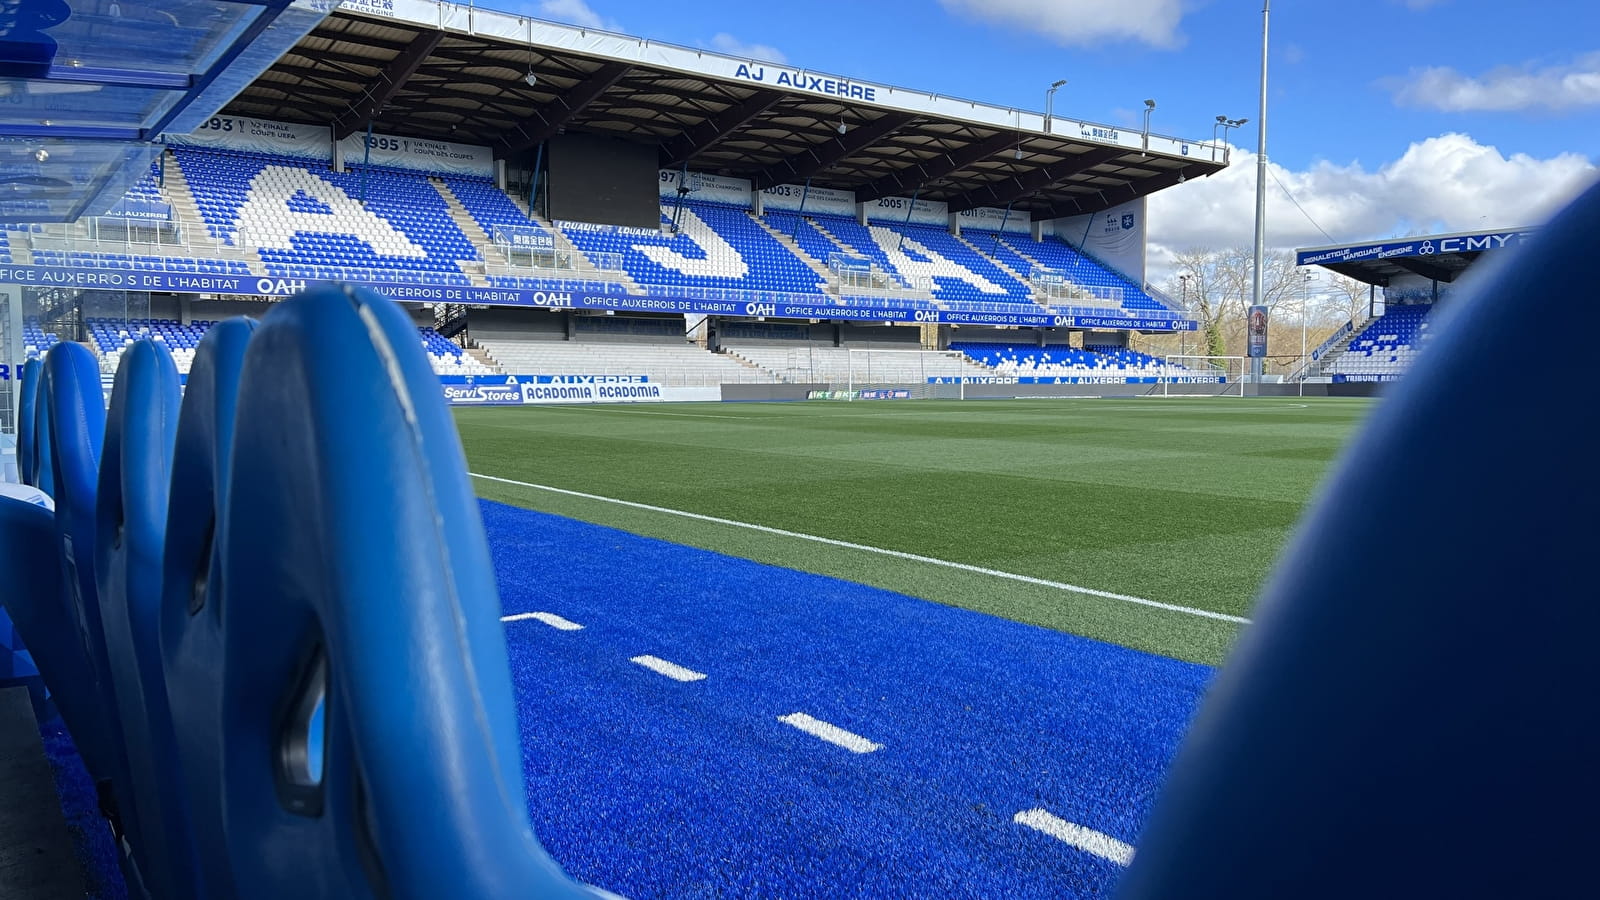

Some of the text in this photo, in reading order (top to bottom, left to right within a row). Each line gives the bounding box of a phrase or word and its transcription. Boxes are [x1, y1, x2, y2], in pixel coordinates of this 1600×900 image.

[351, 4, 394, 17] PACKAGING
[735, 64, 876, 101] AJ AUXERRE
[264, 123, 290, 131] FINALE
[251, 129, 296, 140] COUPE UEFA
[660, 171, 676, 182] 97
[878, 199, 902, 208] 2005
[125, 210, 168, 219] AUXERRE
[1303, 249, 1350, 264] SIGNALETIQUE
[1343, 246, 1383, 260] MARQUAGE
[1378, 246, 1413, 259] ENSEIGNE
[0, 269, 240, 290] FICE AUXERROS DE L'HABITAT
[256, 278, 306, 294] OAH
[373, 286, 520, 302] AUXERROIS DE L'HABITAT
[533, 292, 571, 306] OAH
[583, 296, 736, 312] OFFICE AUXERROIS DE L'HABITAT
[746, 303, 776, 316] OAH
[785, 307, 907, 319] OFFICE AUXERROIS DE L'HABITAT
[914, 310, 939, 321] OAH
[946, 313, 1048, 324] OFFICE AUXERROIS DE L'HABITAT
[1054, 316, 1075, 326] OAH
[1081, 318, 1100, 326] OFFICE
[1101, 319, 1132, 327] AUXERROIS
[1171, 320, 1189, 330] OAH
[550, 376, 642, 384] AUXERRE
[1177, 376, 1220, 384] AUXERRE
[444, 386, 519, 402] ServiStores
[527, 387, 592, 400] ACADOMIA
[600, 386, 660, 398] ACADOMIA
